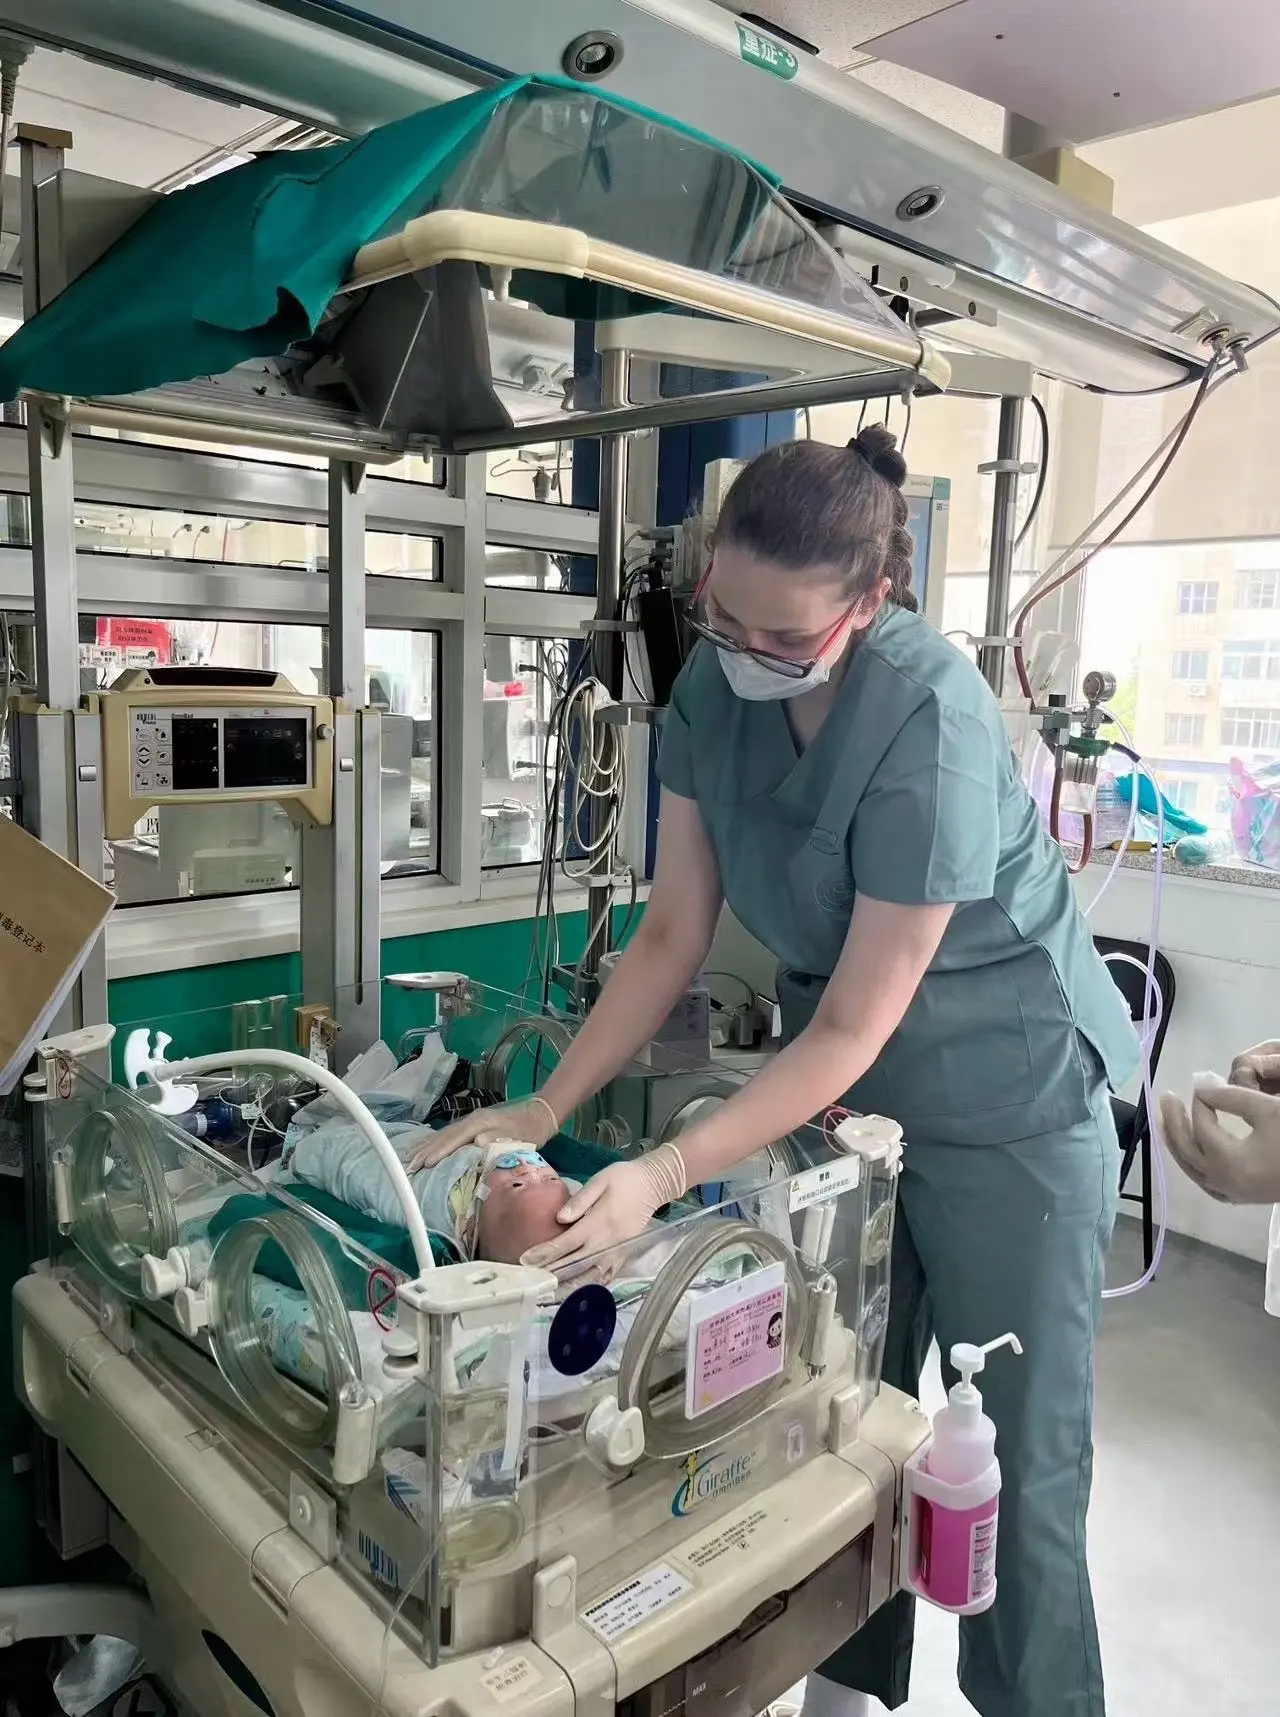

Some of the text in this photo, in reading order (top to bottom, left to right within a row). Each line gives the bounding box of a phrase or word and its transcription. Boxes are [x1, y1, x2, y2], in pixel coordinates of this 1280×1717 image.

[742, 29, 796, 68] 重症-3
[0, 912, 46, 953] 毒登记本
[697, 1455, 752, 1498] Giraffe
